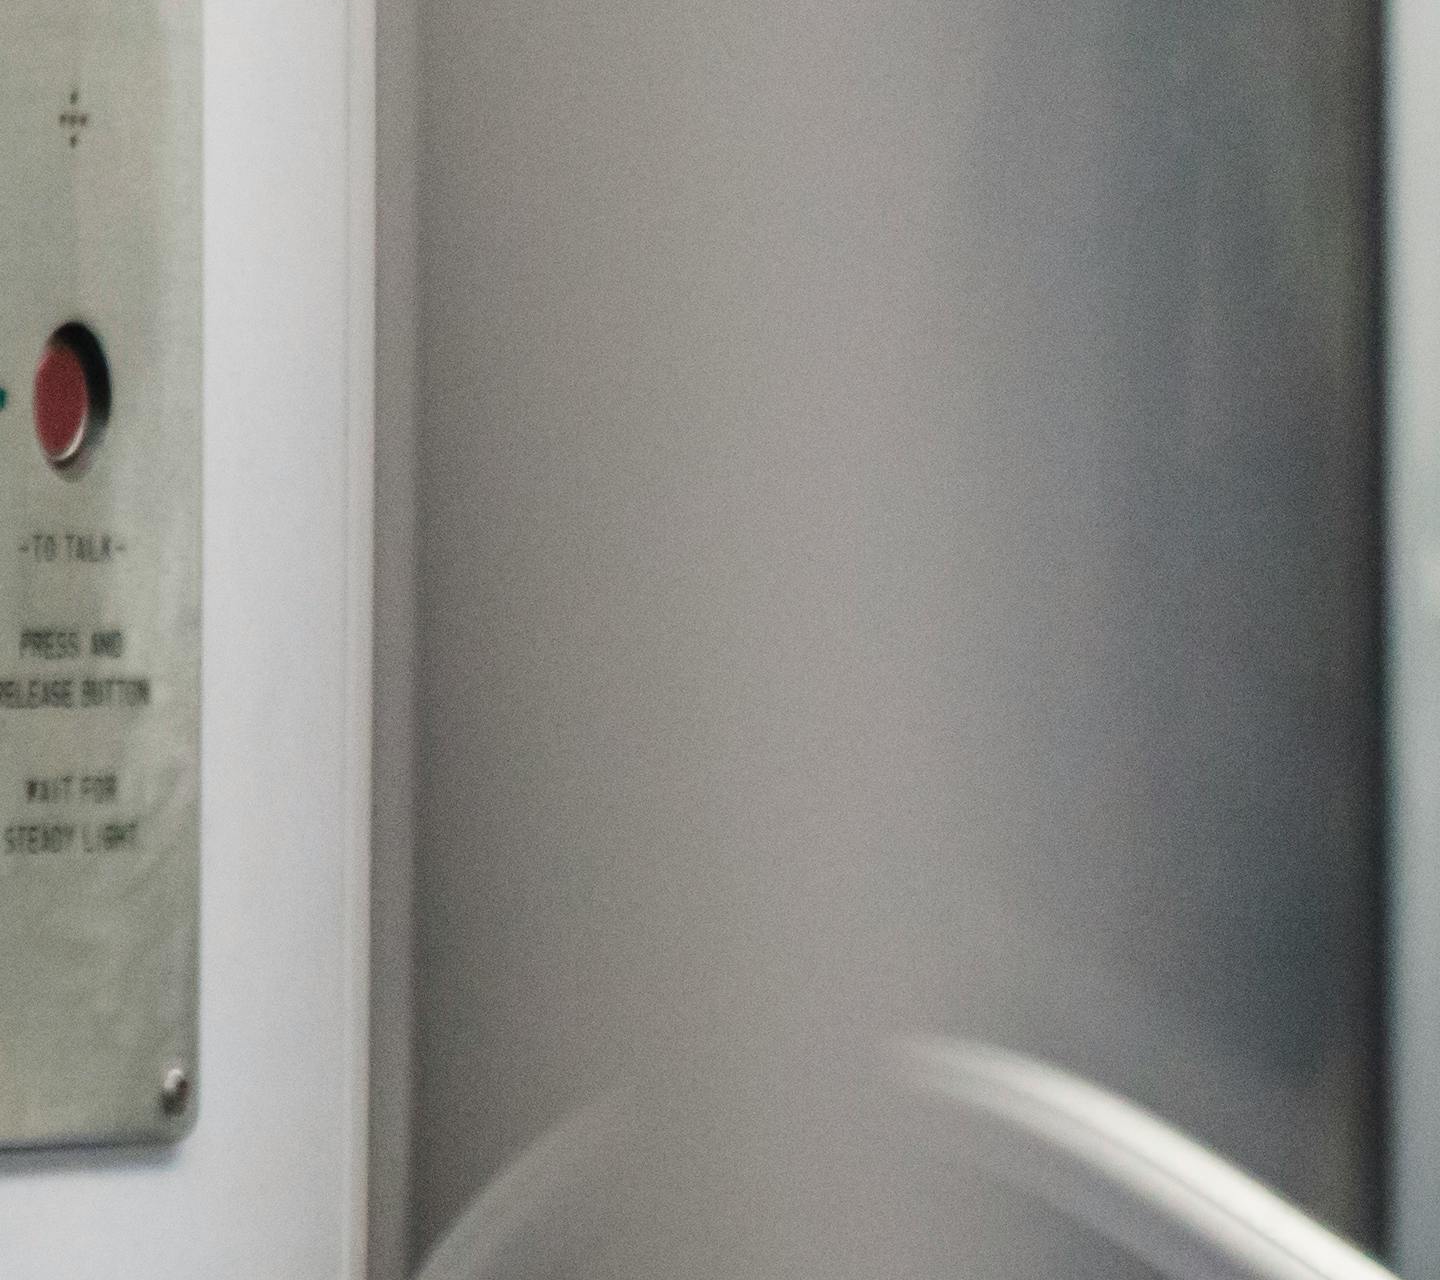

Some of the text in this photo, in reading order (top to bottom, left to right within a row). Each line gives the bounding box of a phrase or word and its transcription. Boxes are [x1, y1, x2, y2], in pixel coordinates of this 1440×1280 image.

[19, 629, 80, 659] PRESS
[80, 679, 150, 708] BUTTON
[27, 777, 73, 803] WAIT
[4, 820, 138, 854] STEADY LIGHT
